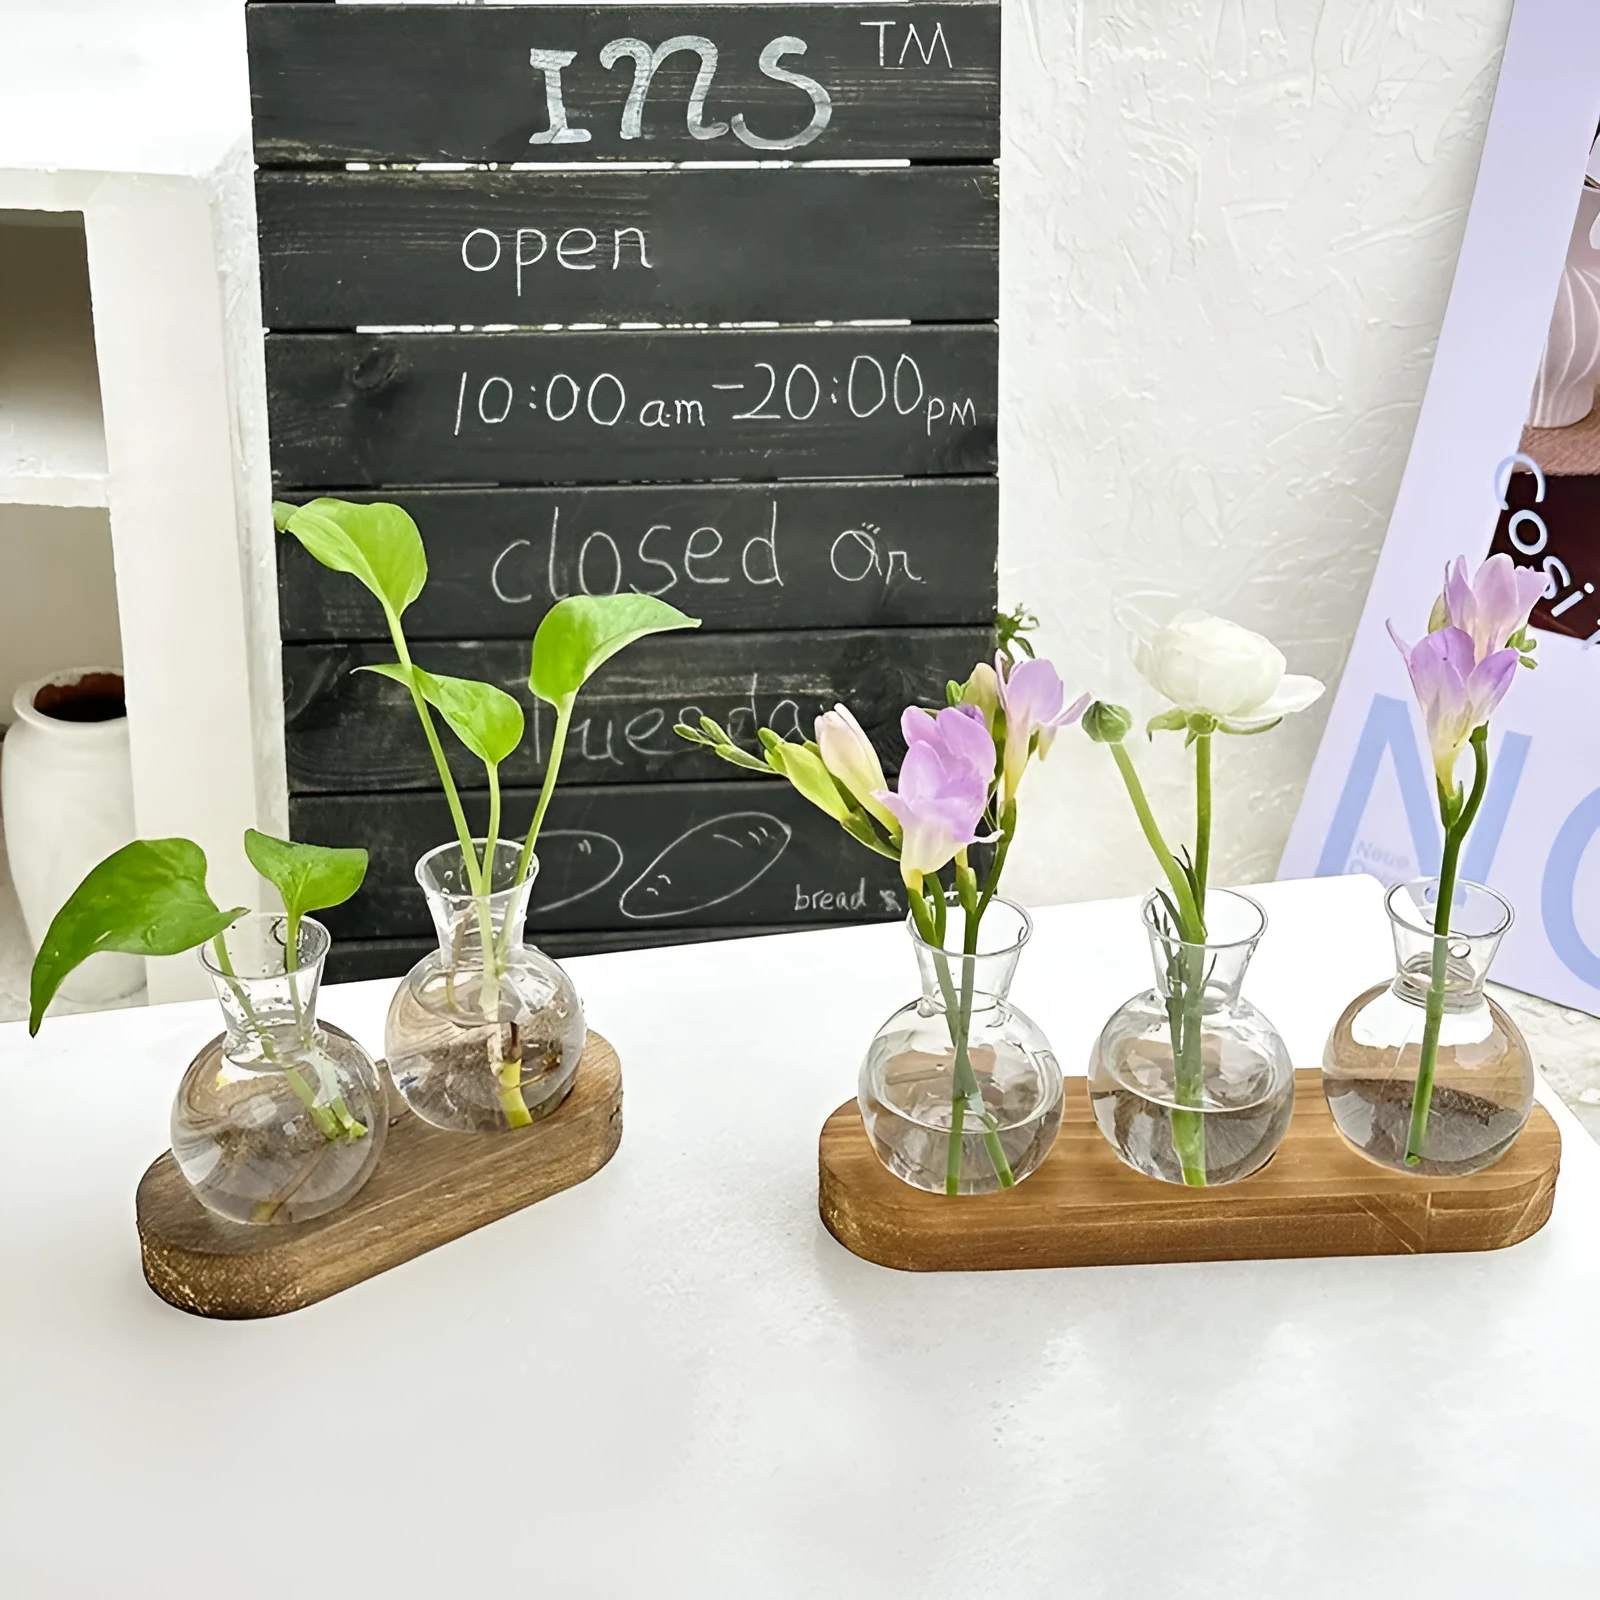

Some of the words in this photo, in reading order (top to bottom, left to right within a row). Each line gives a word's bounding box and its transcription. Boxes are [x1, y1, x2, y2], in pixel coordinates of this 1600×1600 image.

[860, 21, 953, 68] TM
[461, 226, 653, 297] open
[491, 501, 784, 603] closed
[794, 877, 867, 911] bread
